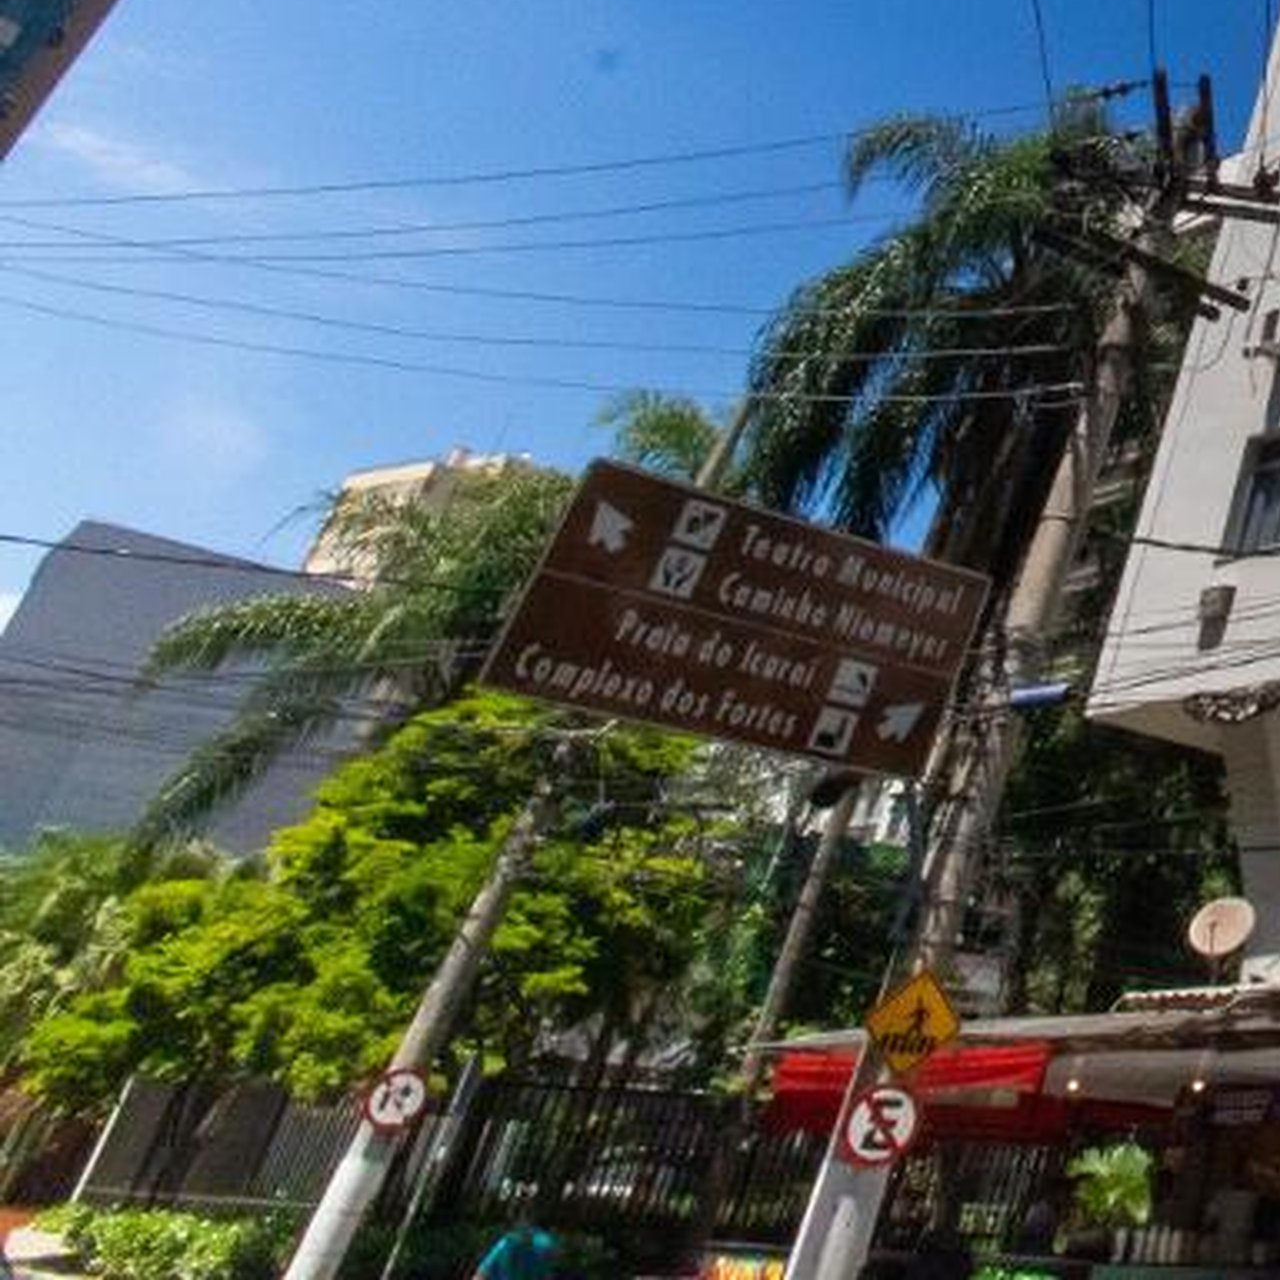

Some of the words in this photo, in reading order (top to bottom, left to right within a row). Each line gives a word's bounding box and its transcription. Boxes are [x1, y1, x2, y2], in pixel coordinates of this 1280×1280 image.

[741, 525, 830, 577] Teatro
[837, 555, 965, 614] Municipal
[615, 608, 692, 655] Praia
[718, 572, 828, 626] Caminho
[833, 604, 949, 659] Niemeyer
[515, 642, 655, 704] Complexo
[660, 677, 710, 718] dos
